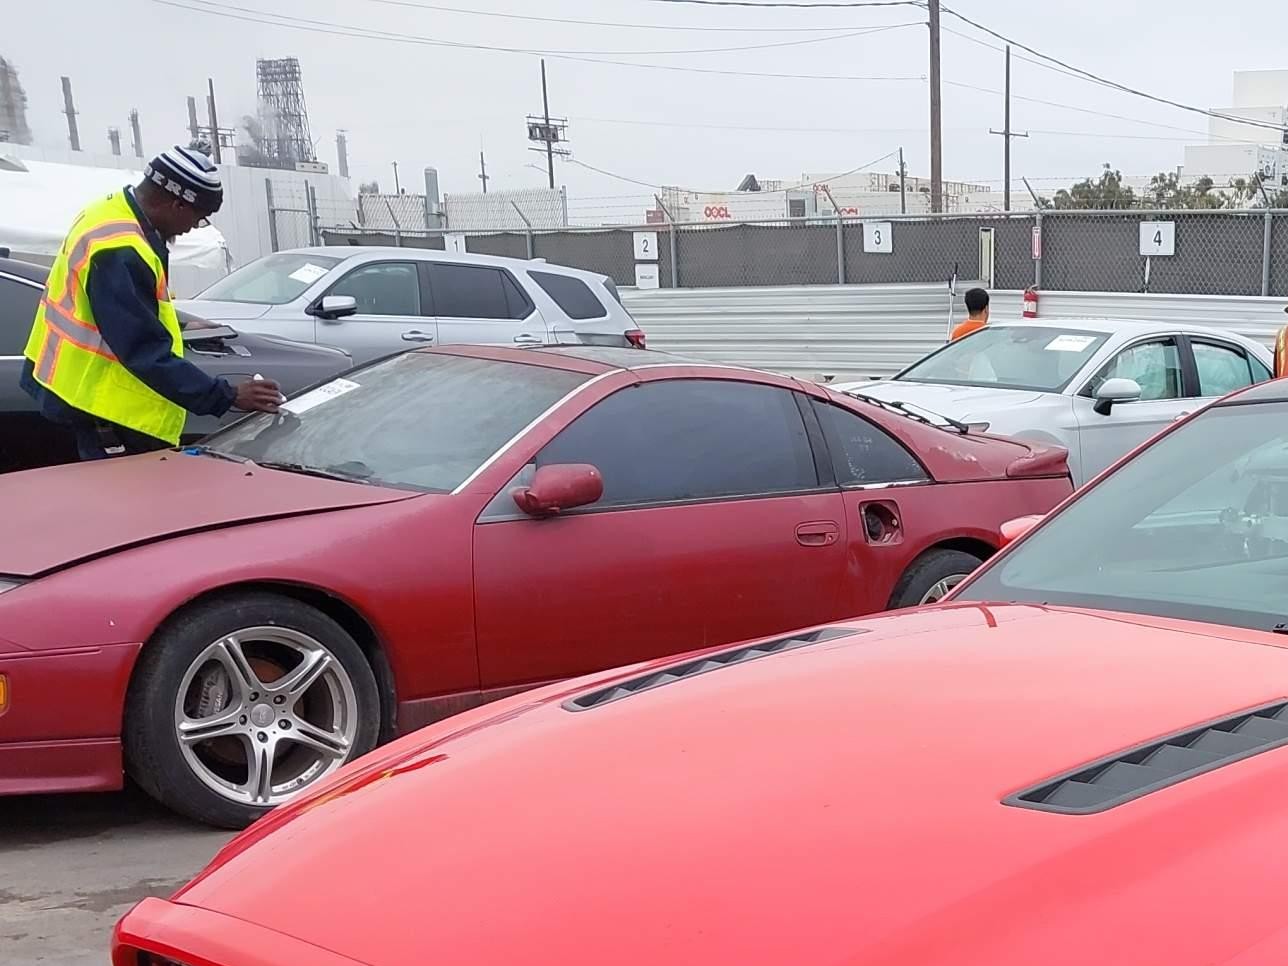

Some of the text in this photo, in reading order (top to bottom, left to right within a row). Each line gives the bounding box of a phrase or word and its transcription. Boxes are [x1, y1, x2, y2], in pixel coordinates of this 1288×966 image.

[704, 206, 732, 219] OOCL
[874, 230, 882, 245] 3
[1153, 230, 1162, 247] 4
[642, 239, 649, 253] 2
